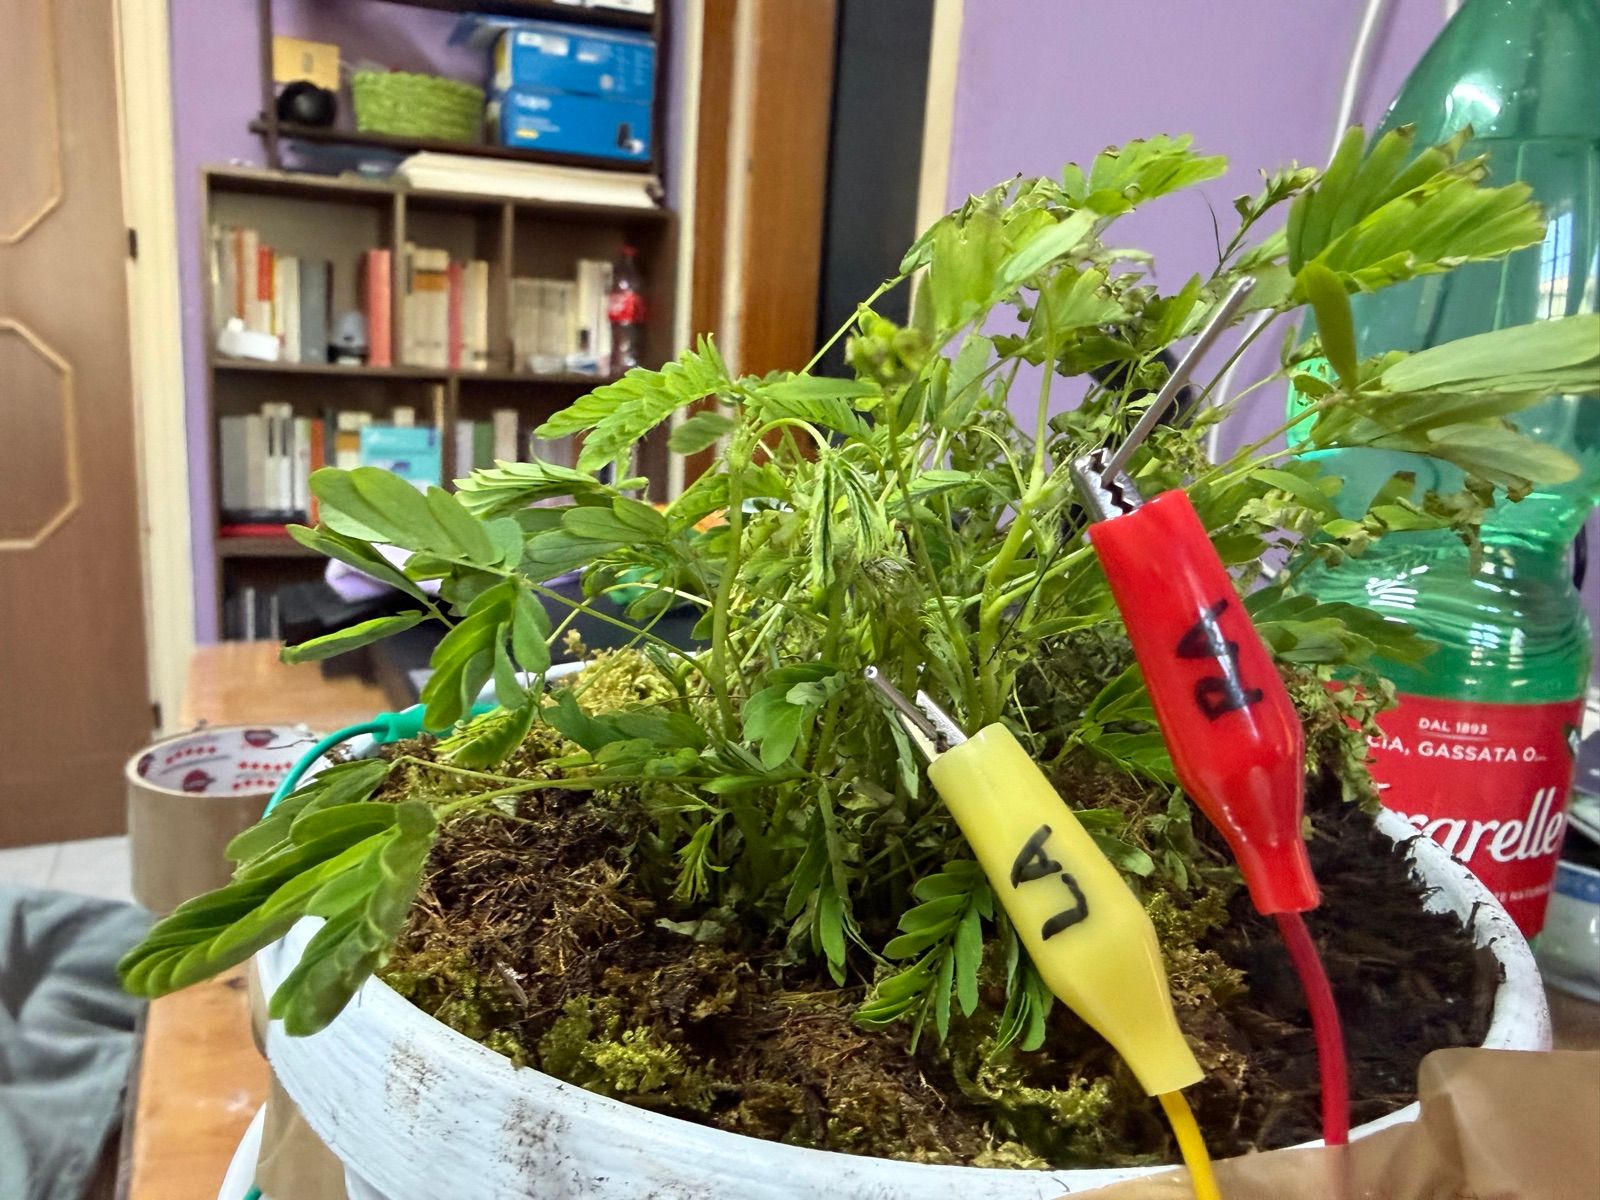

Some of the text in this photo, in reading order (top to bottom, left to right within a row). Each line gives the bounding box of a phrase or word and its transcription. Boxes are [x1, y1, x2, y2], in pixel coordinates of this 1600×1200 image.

[1176, 598, 1264, 722] RA
[1366, 734, 1410, 756] CIA,
[1418, 741, 1517, 762] GASSATA
[1418, 716, 1488, 736] DAL 1893
[1010, 824, 1089, 941] LA
